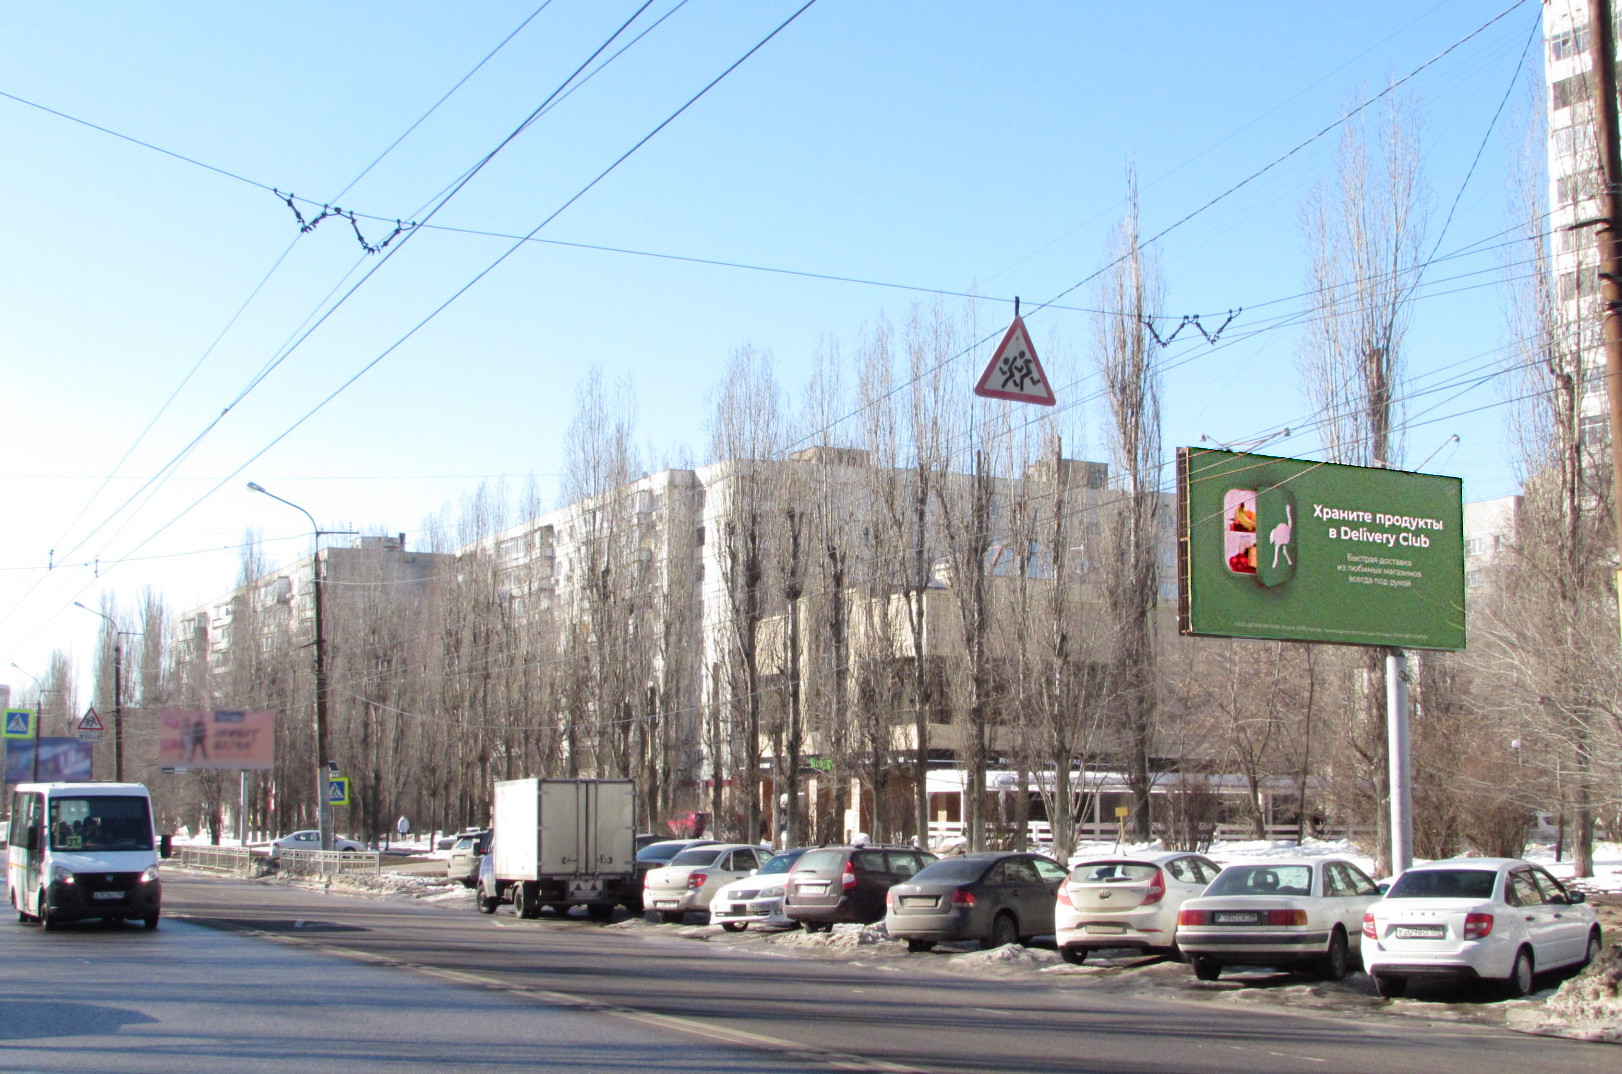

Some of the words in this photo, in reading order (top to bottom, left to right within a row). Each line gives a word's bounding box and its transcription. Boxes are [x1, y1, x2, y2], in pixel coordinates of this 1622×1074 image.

[1313, 504, 1373, 523] Храните
[1376, 513, 1443, 530] продукты
[1329, 528, 1337, 538] в
[1340, 526, 1396, 547] Delivery
[1399, 532, 1430, 548] Club
[1347, 553, 1378, 564] Быстрая
[1379, 557, 1412, 566] доставка
[1347, 564, 1384, 574] любимых
[1348, 575, 1373, 584] всегда
[1374, 578, 1388, 586] под
[1389, 579, 1412, 588] рукой
